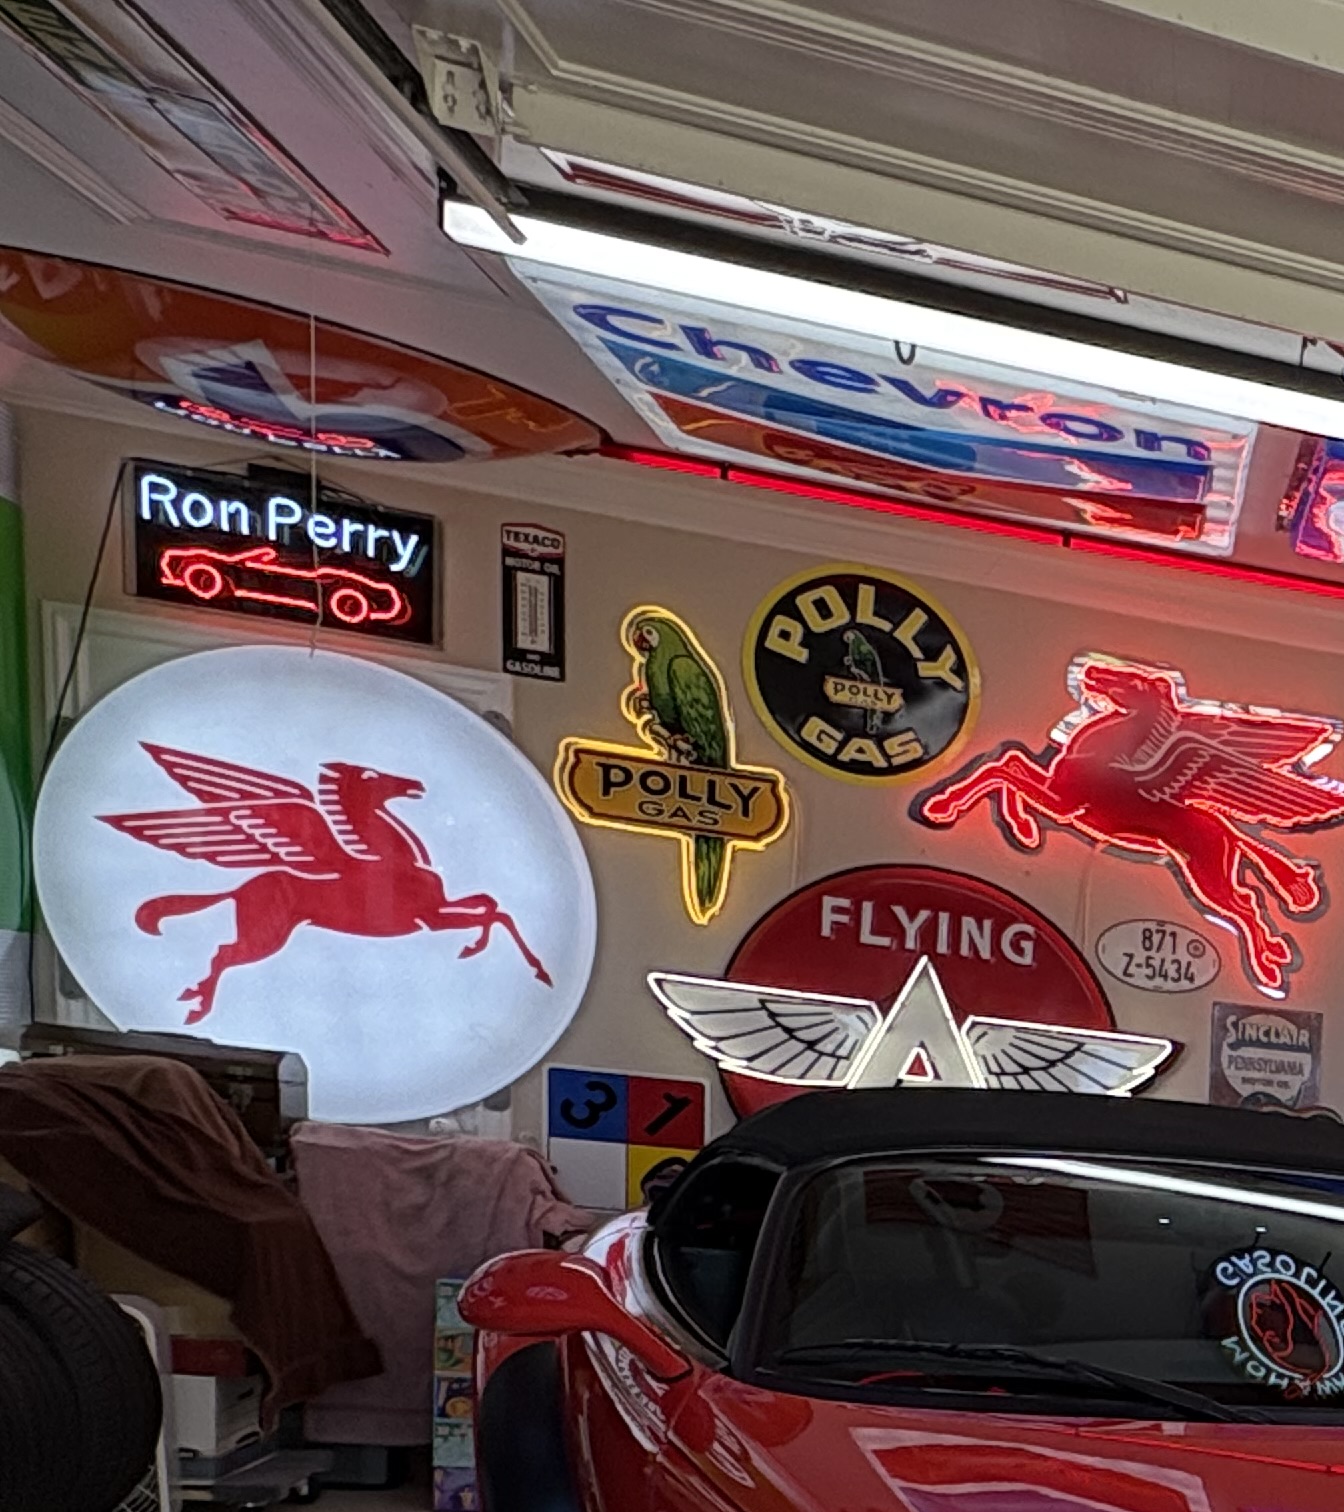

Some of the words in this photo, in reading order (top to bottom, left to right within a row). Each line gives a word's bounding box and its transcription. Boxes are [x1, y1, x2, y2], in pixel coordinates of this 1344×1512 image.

[572, 303, 1212, 461] Chevron
[140, 473, 251, 535] Ron
[266, 497, 420, 571] Perry
[504, 529, 560, 550] TEXACO
[764, 583, 965, 692] POLLY
[832, 681, 896, 705] POLLY
[800, 716, 924, 768] GAS
[595, 761, 761, 818] POLLY
[638, 801, 721, 827] GAS
[819, 896, 1039, 967] FLYING
[1142, 928, 1178, 955] 871
[1122, 952, 1196, 984] Z-5434
[1226, 1014, 1311, 1049] SINCLAIR
[560, 1080, 618, 1130] 3
